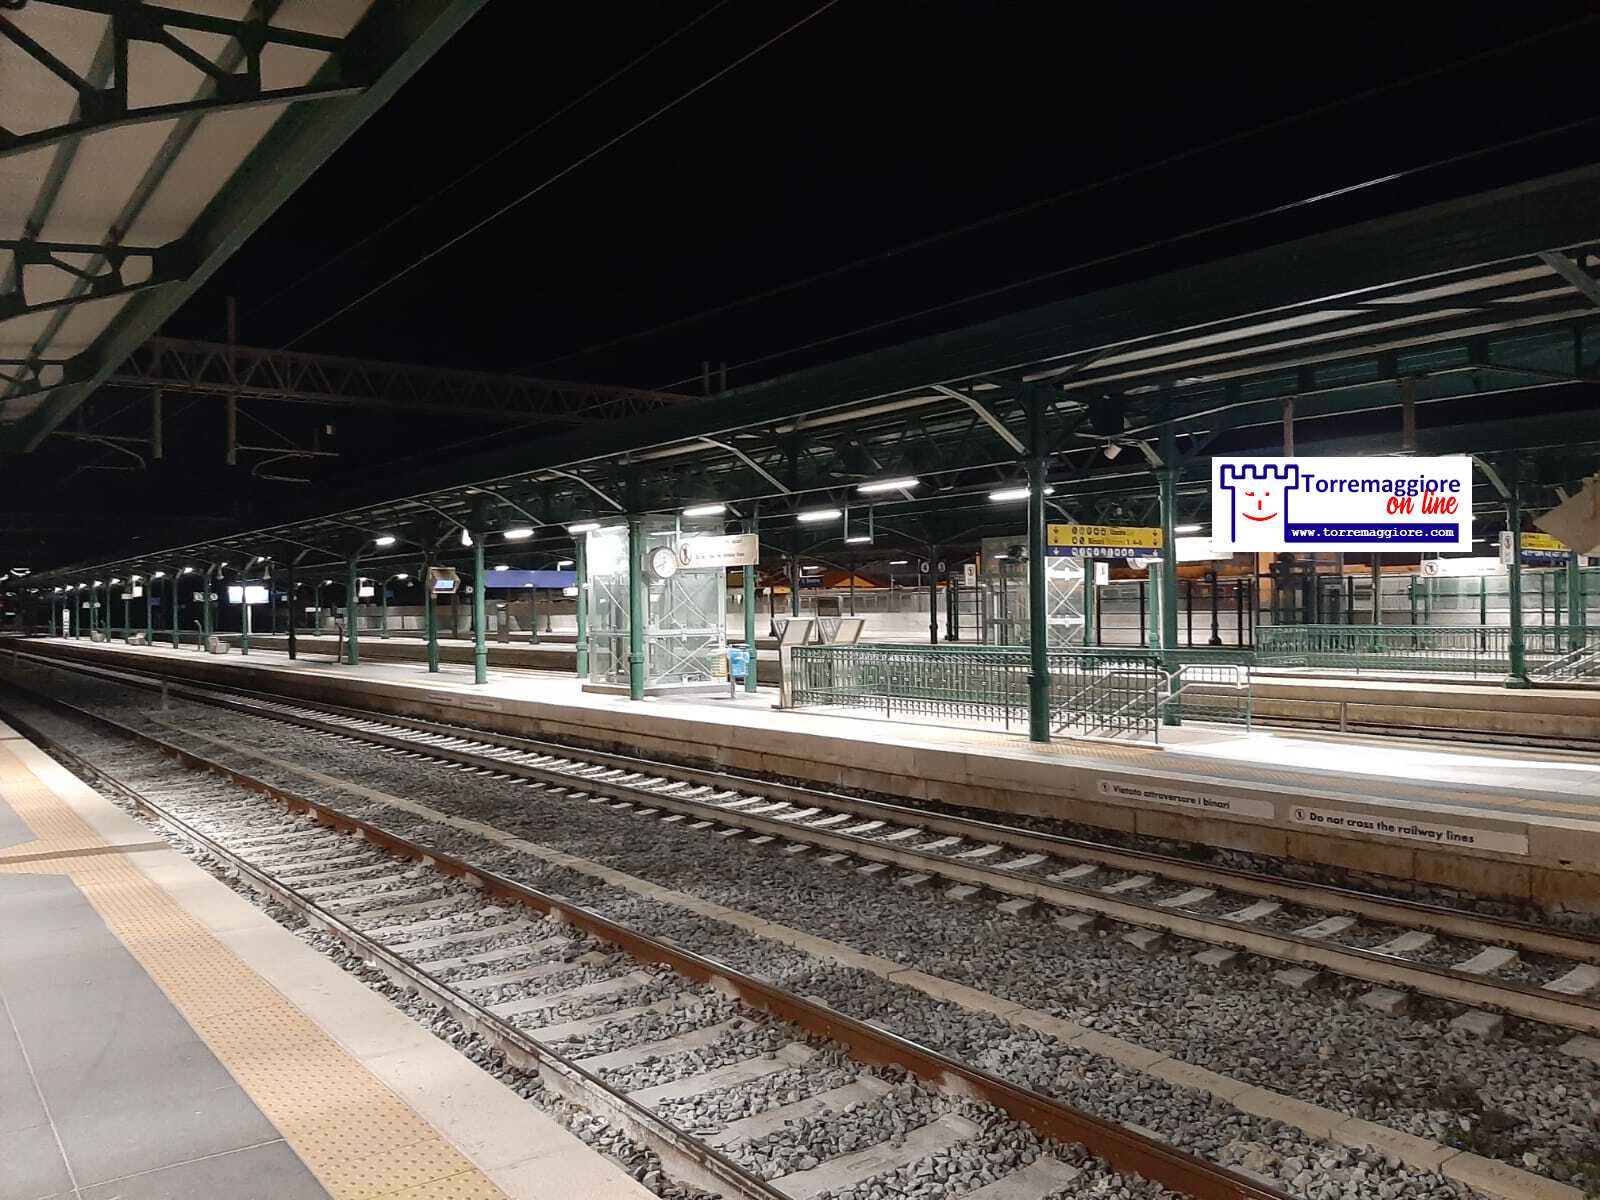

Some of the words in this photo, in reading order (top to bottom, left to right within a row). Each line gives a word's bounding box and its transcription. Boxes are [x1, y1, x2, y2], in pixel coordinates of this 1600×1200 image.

[1113, 785, 1142, 797] Vietato
[1144, 791, 1196, 804] attraversare
[1203, 797, 1229, 809] binari
[1309, 811, 1324, 823] Do
[1326, 815, 1345, 825] not
[1347, 818, 1374, 830] cross
[1376, 821, 1395, 833] the
[1398, 825, 1444, 841] railway
[1446, 829, 1475, 844] lines
